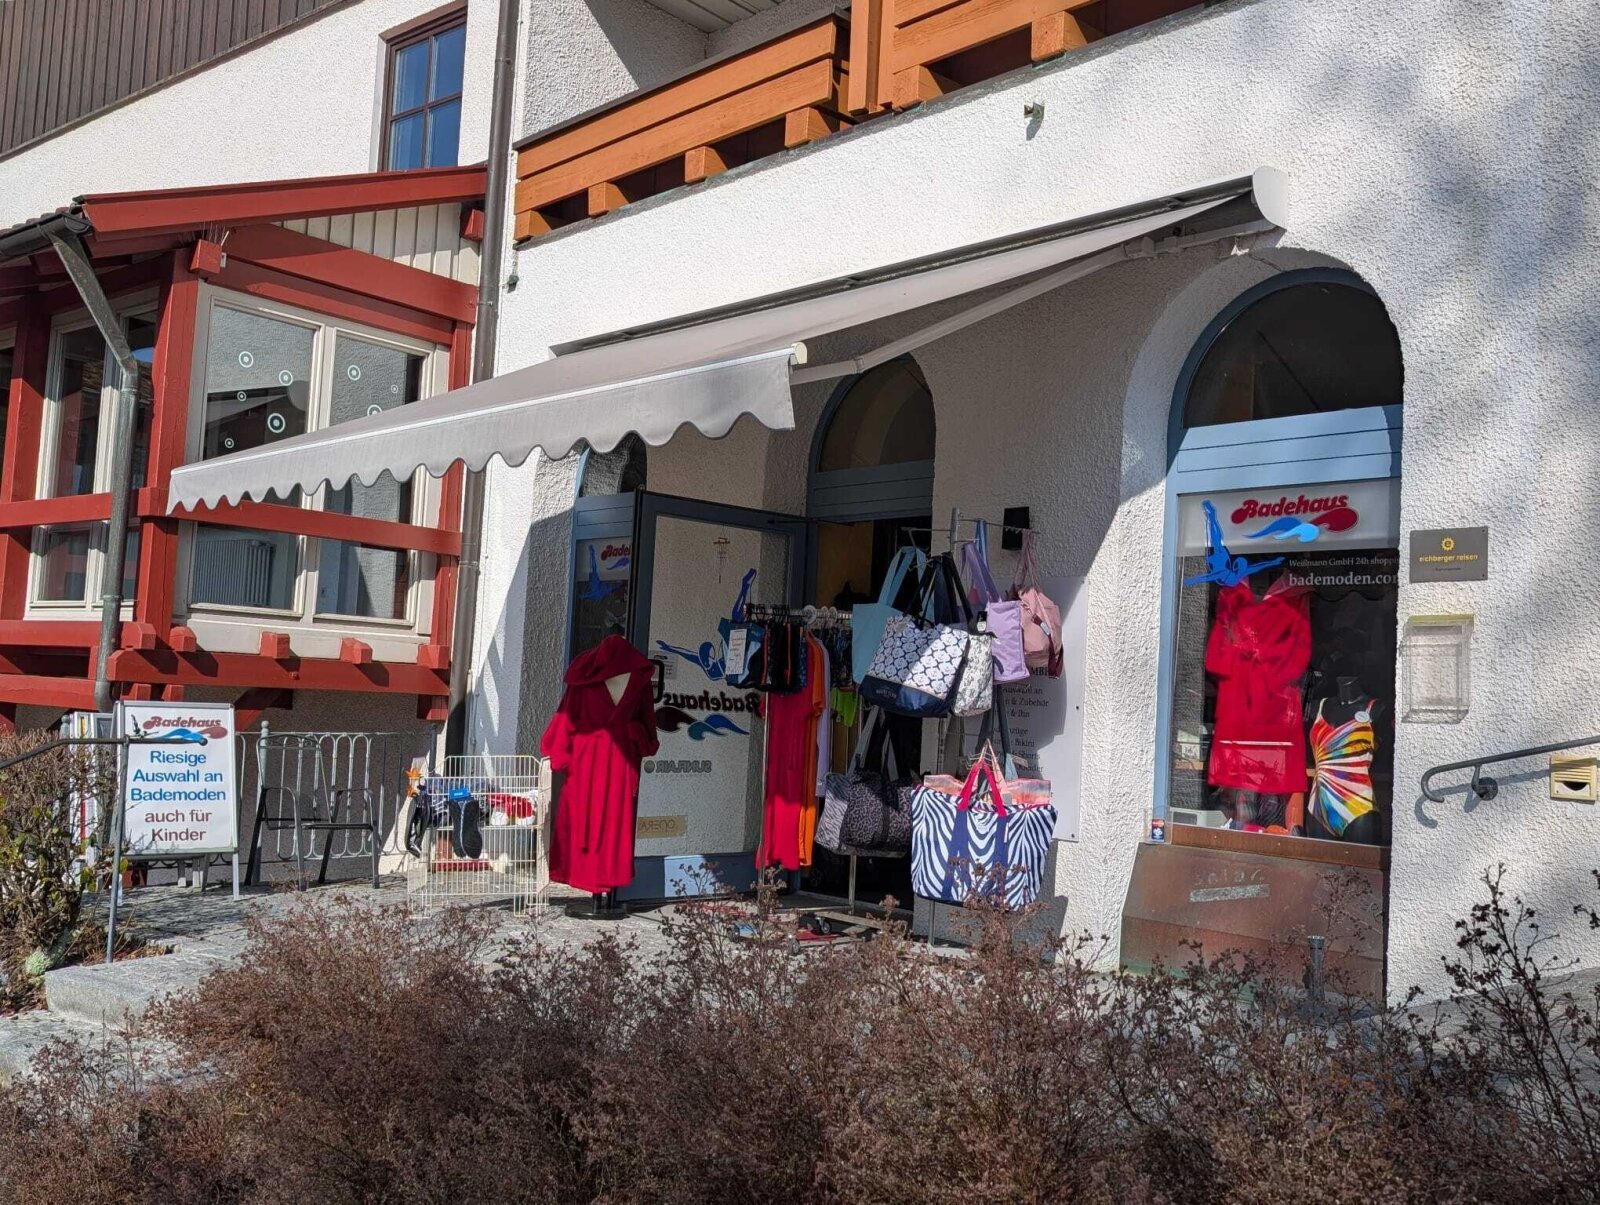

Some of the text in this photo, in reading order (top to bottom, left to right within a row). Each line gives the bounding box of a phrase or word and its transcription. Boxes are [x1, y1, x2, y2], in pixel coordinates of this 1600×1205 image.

[1231, 494, 1349, 524] Badehaus
[1328, 557, 1354, 566] GmbH
[1355, 557, 1369, 566] 24h
[1456, 553, 1478, 561] reisen
[143, 716, 221, 730] Badehaus
[150, 751, 207, 767] Riesige
[133, 769, 223, 782] Auswahl an
[131, 788, 226, 801] Bademoden
[145, 809, 213, 823] auch für
[151, 828, 207, 842] Kinder
